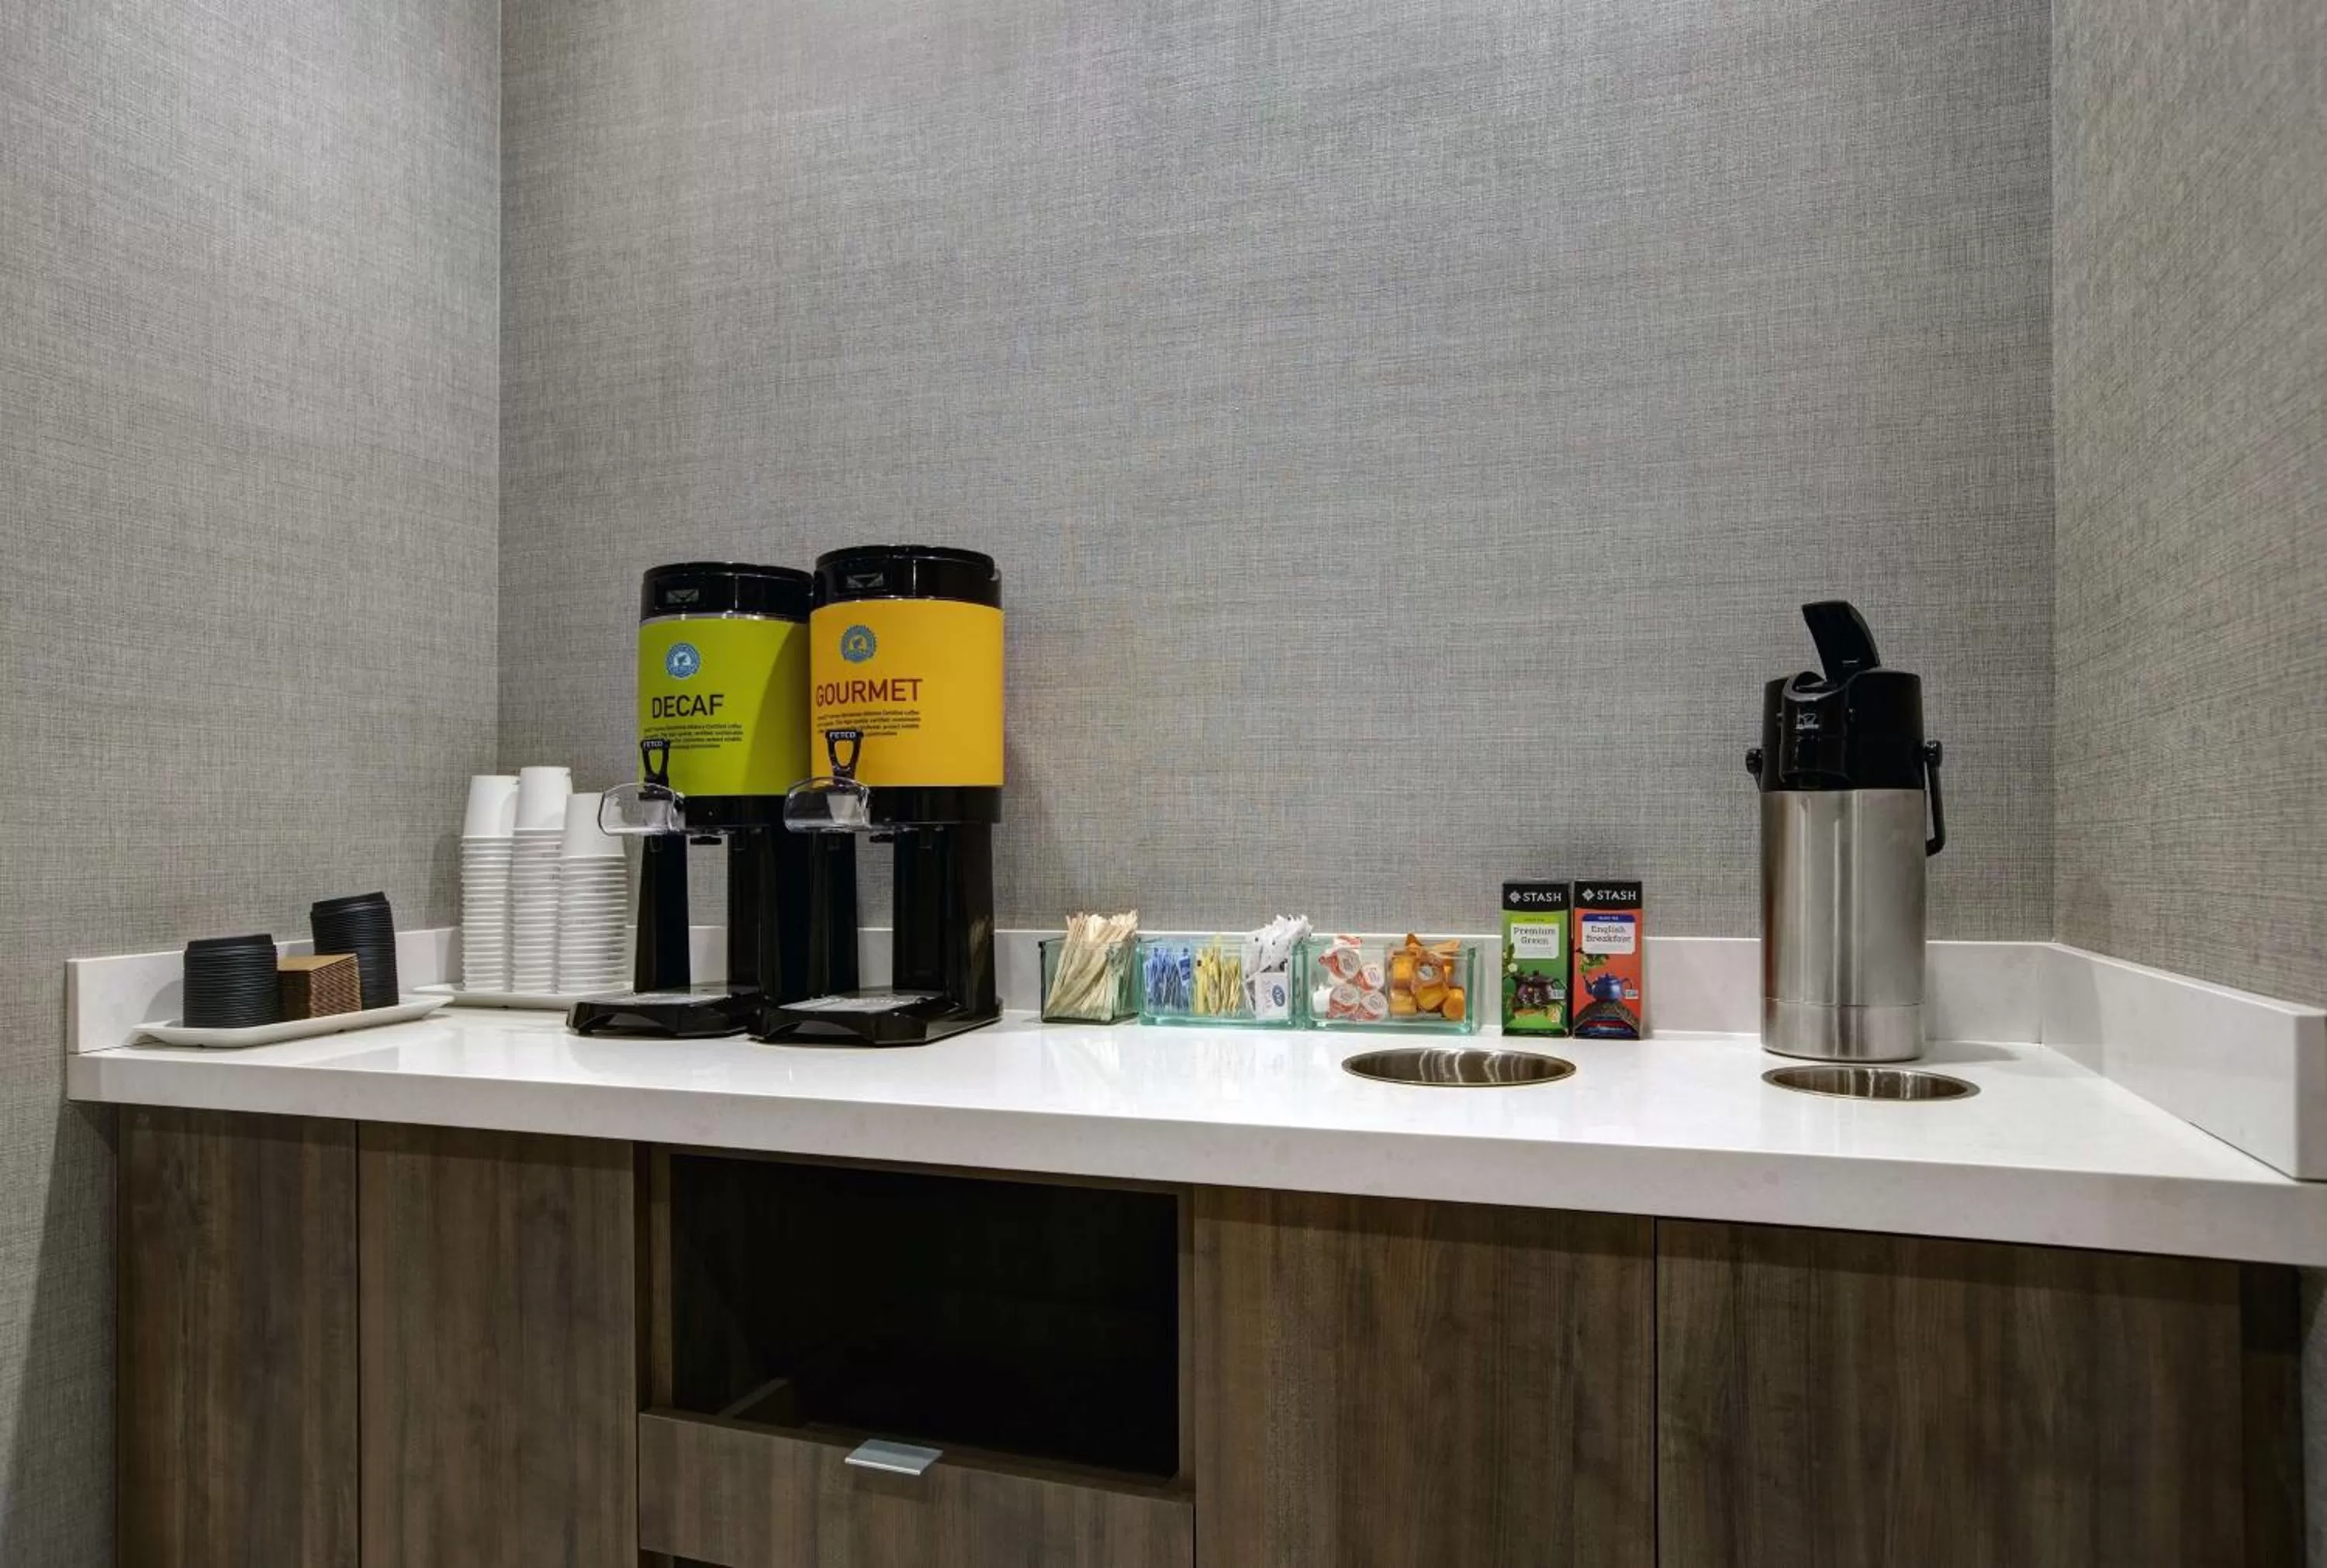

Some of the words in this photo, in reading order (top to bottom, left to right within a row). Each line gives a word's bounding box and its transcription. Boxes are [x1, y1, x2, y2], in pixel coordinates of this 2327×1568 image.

[816, 678, 923, 707] GOURMET
[652, 694, 724, 719] DECAF
[1523, 893, 1561, 902] STASH
[1597, 889, 1636, 900] STASH
[1520, 936, 1549, 945] Green
[1586, 934, 1632, 943] Breakfast
